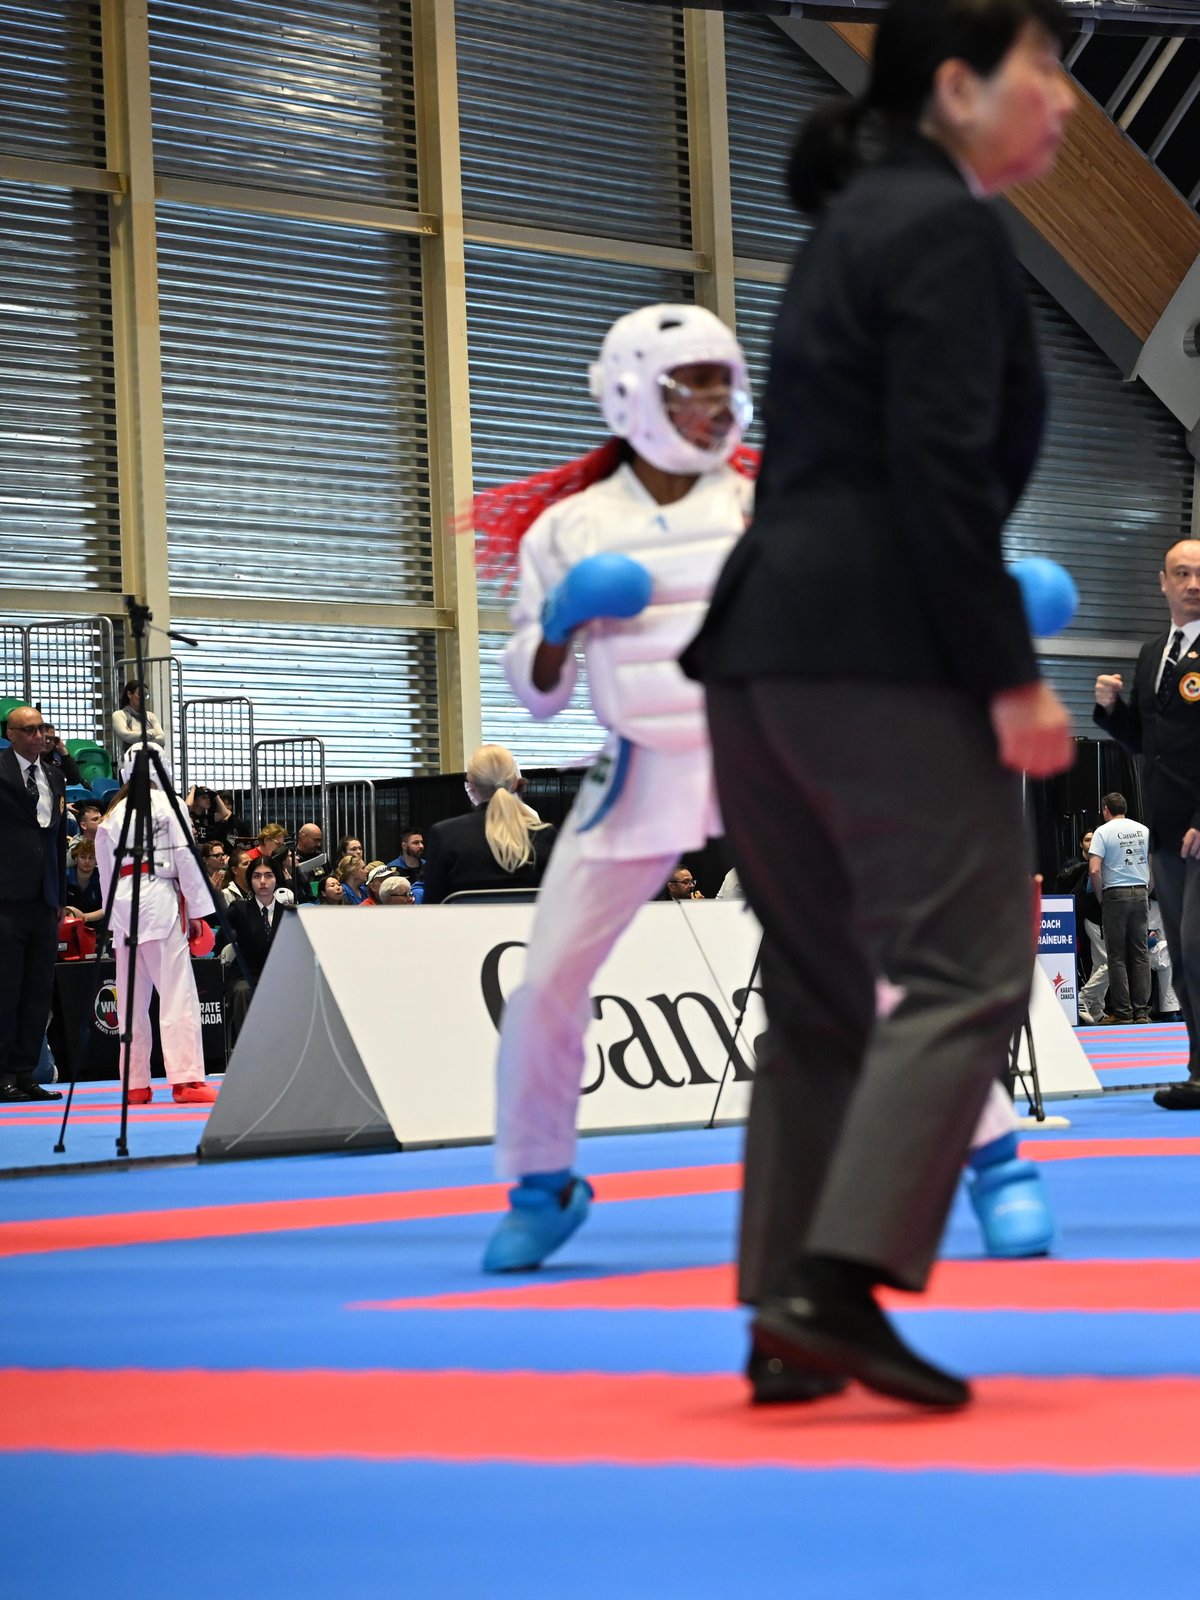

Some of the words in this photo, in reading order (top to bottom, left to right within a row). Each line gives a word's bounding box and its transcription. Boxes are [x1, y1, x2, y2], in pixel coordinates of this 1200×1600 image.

[1038, 933, 1073, 944] RAÎNEUR-E
[200, 1002, 221, 1013] RATE
[201, 1014, 222, 1024] NADA
